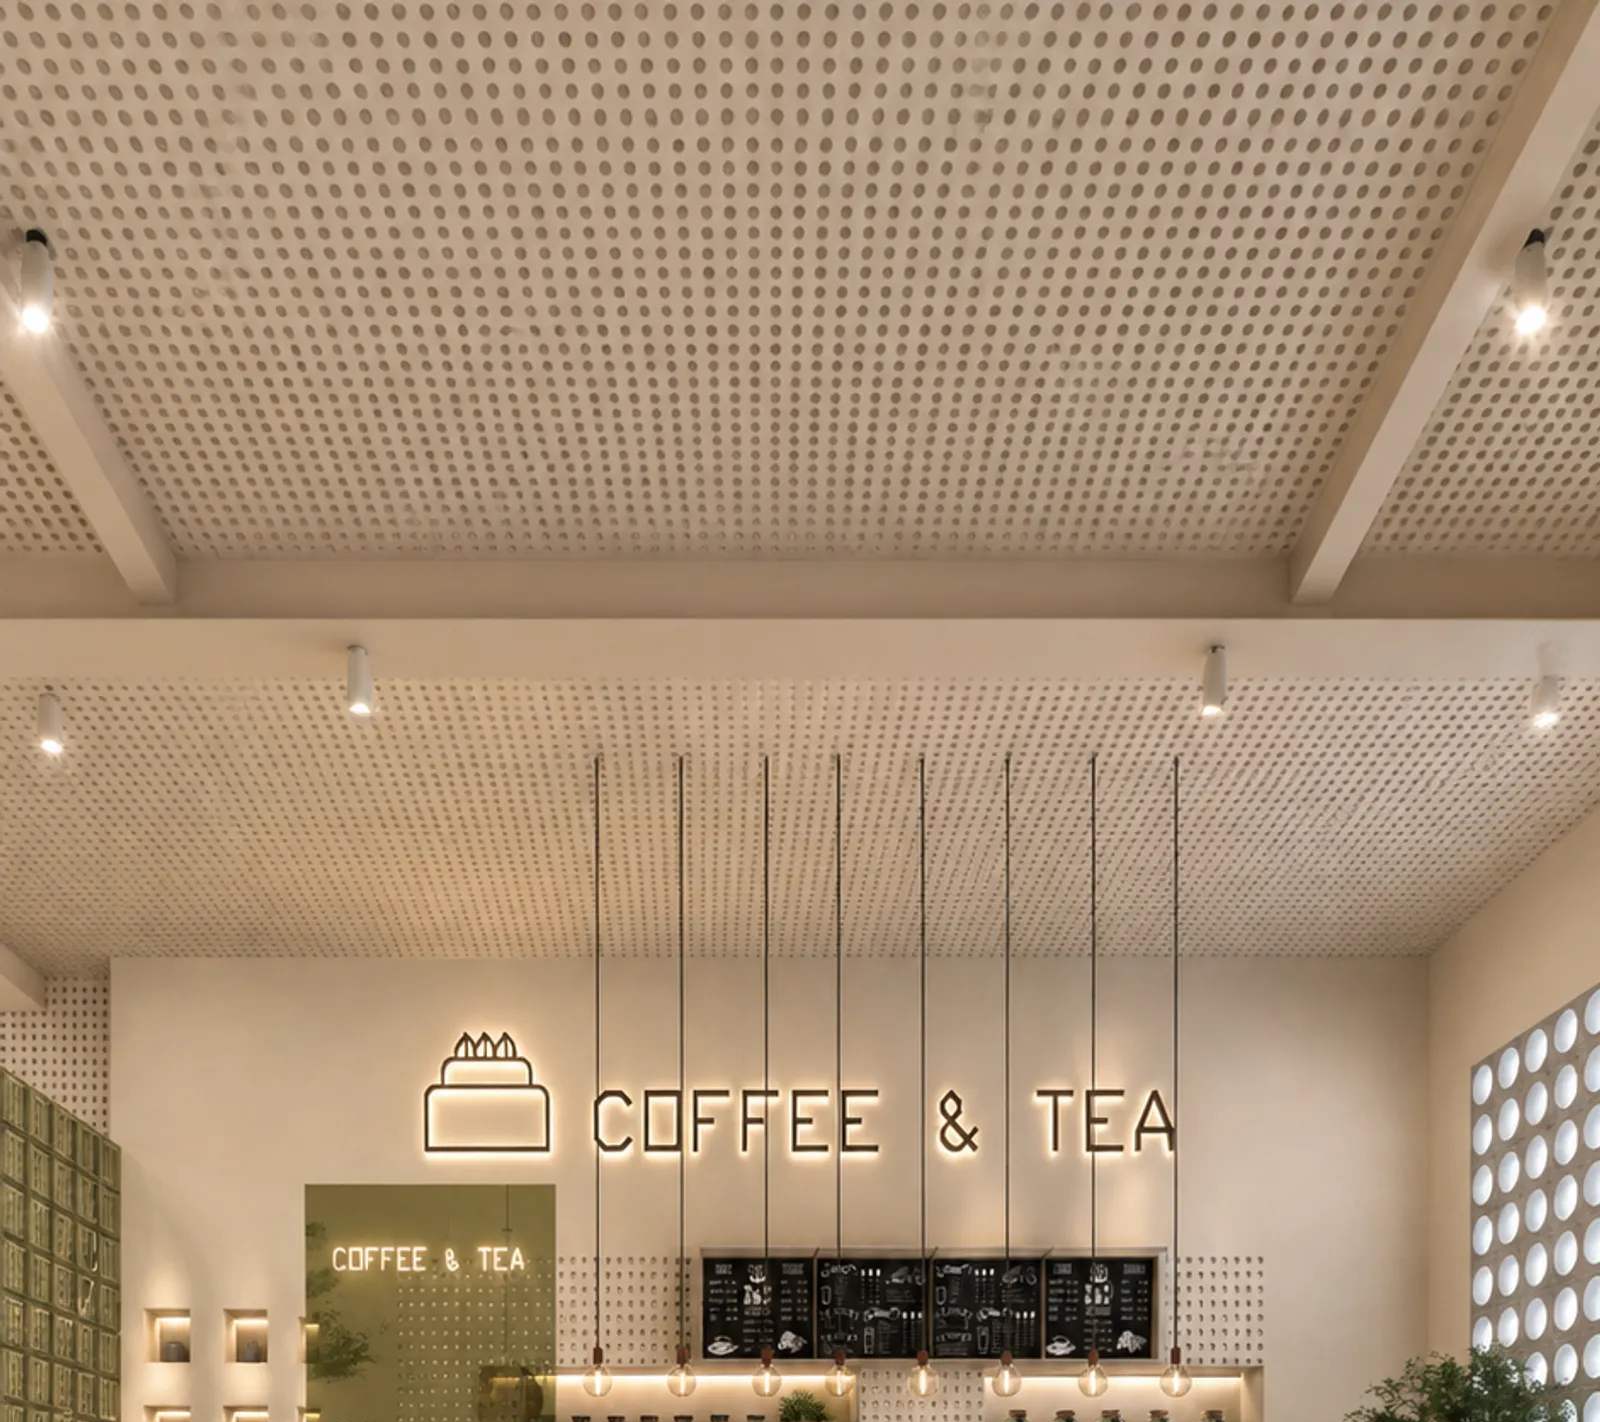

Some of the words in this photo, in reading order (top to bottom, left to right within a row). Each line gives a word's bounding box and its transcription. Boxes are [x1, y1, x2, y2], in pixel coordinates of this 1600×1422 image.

[593, 1089, 879, 1152] COFFEE
[939, 1089, 979, 1152] &
[1036, 1089, 1176, 1152] TEA
[332, 1246, 427, 1272] COFFEE
[444, 1247, 460, 1272] &
[477, 1246, 525, 1272] TEA
